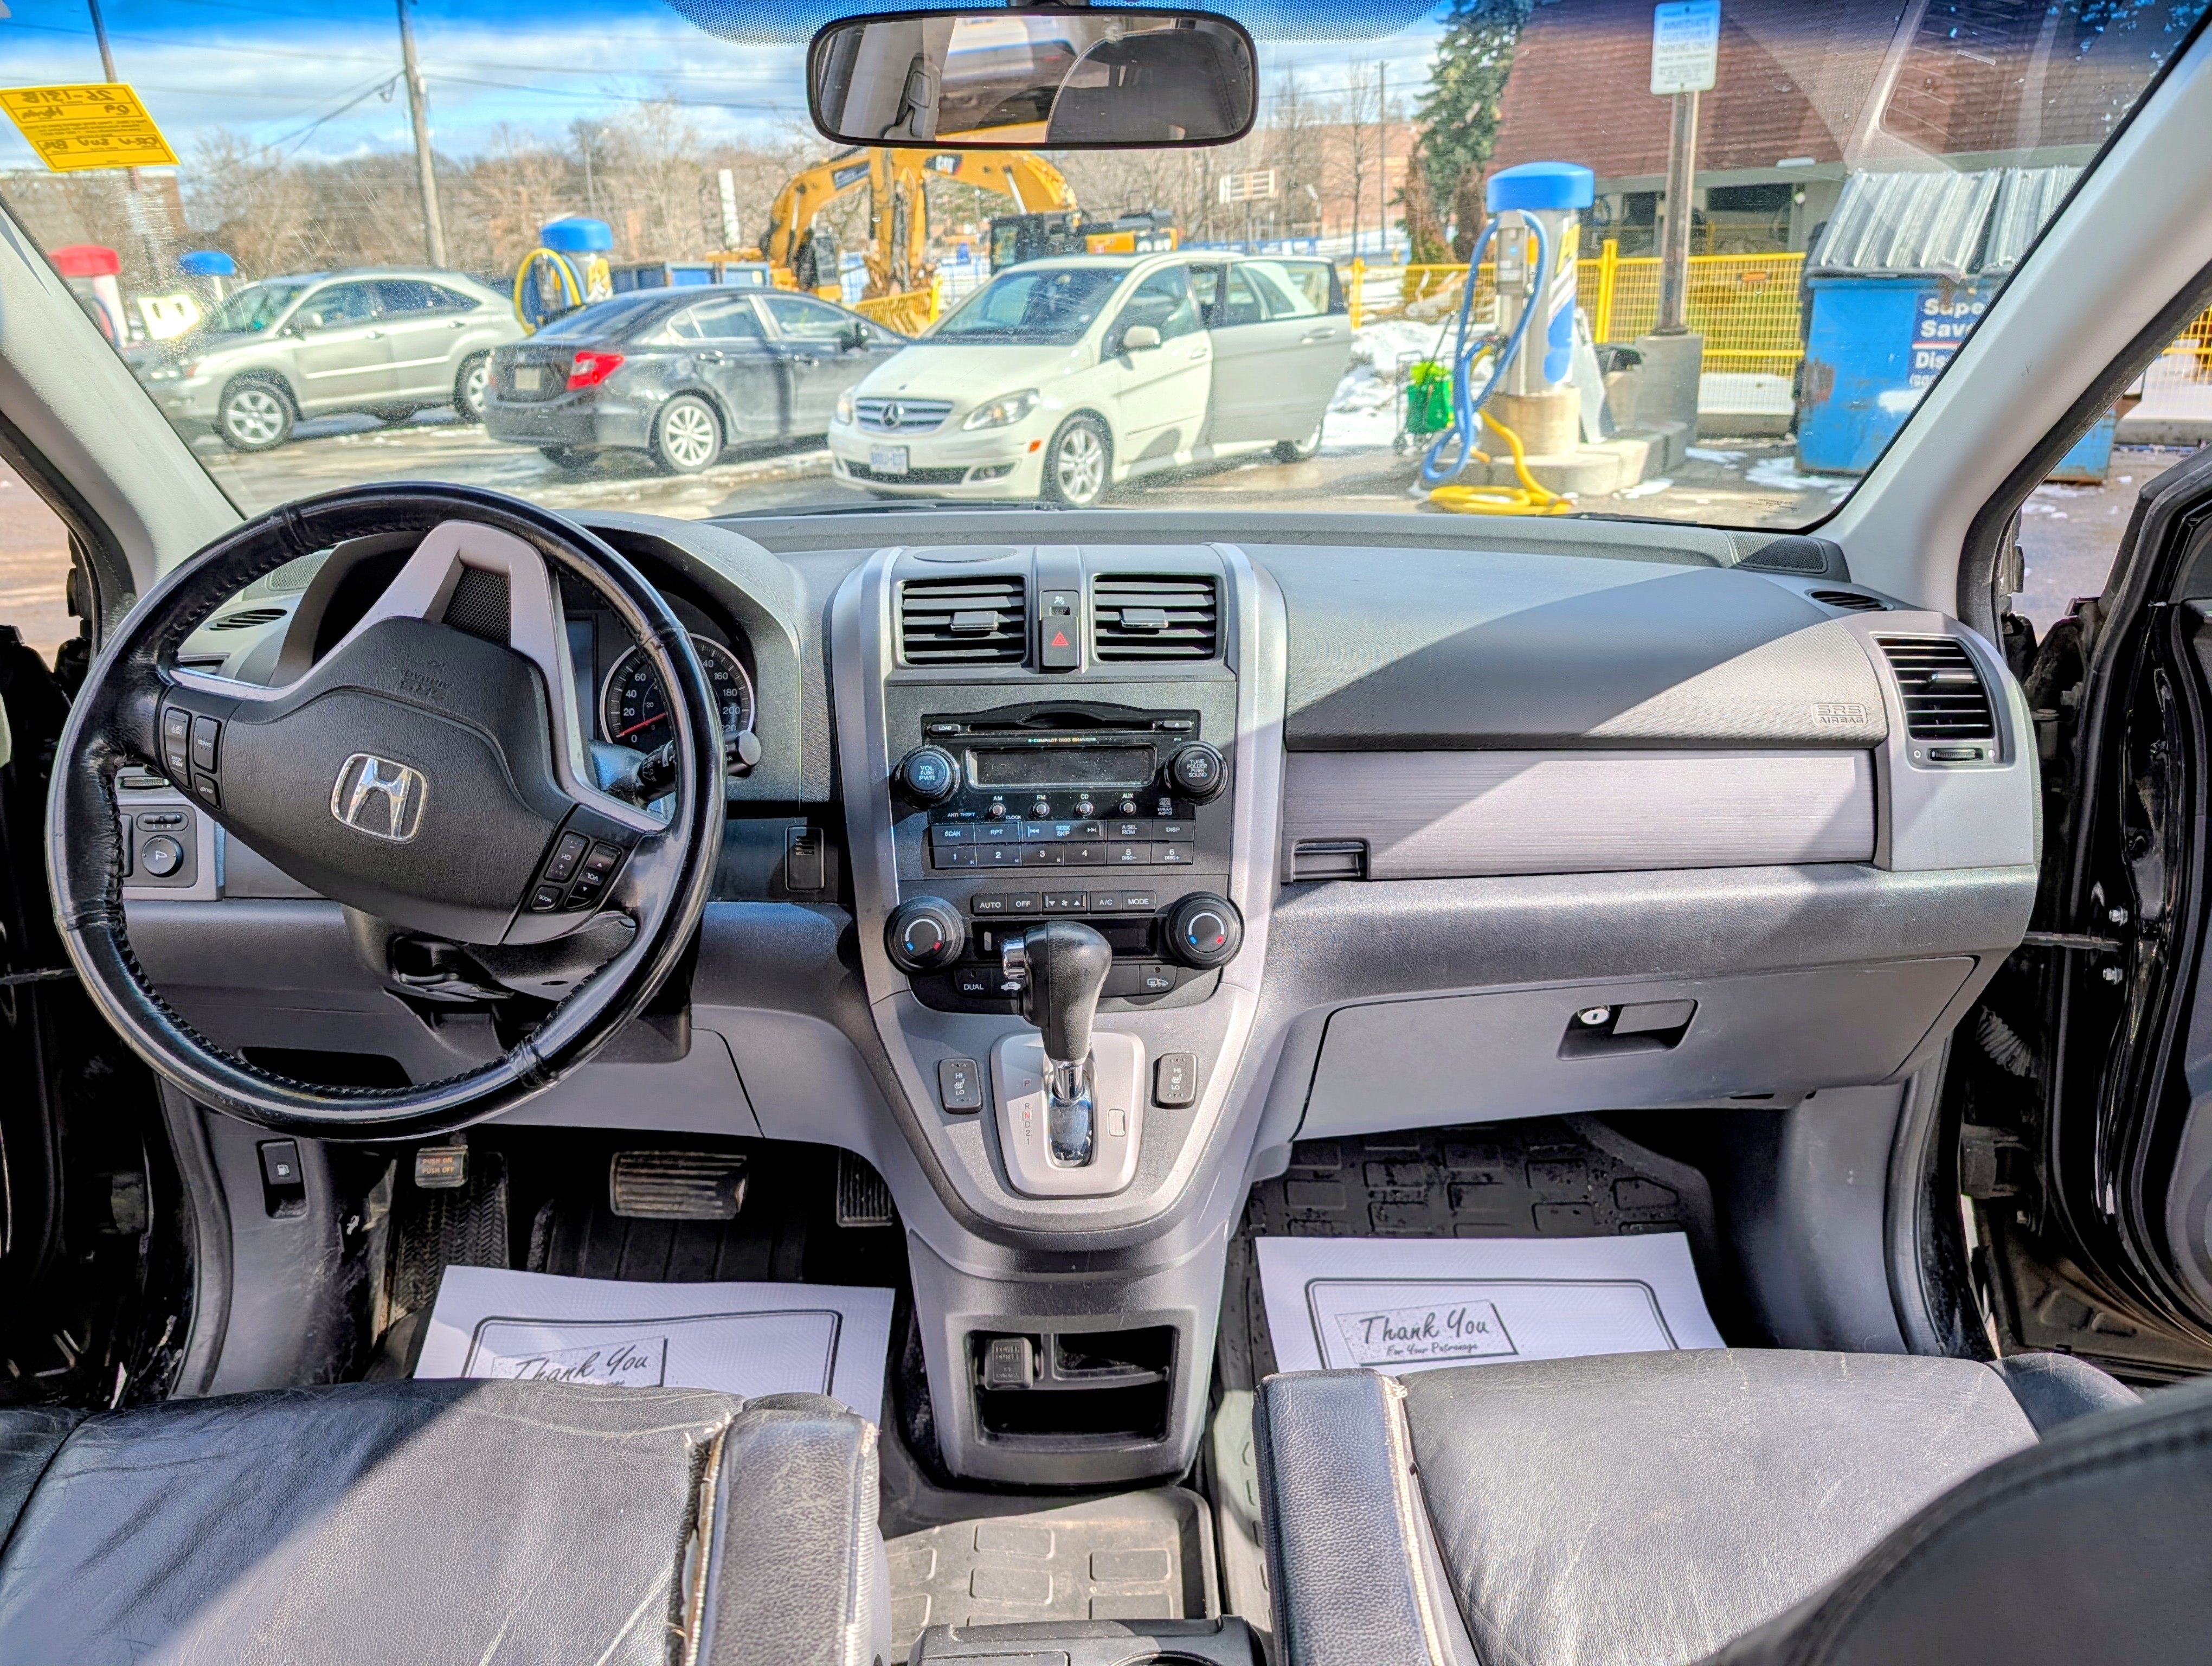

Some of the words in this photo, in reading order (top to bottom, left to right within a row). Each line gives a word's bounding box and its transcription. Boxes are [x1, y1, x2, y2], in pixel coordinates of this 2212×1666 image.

[1924, 298, 1985, 318] Supe
[1915, 351, 1951, 369] Dis
[700, 659, 714, 668] 40
[634, 673, 646, 681] 60
[714, 672, 728, 680] 160
[625, 690, 637, 698] 40
[723, 688, 738, 696] 180
[723, 707, 740, 715] 200
[1817, 705, 1861, 714] SRS
[631, 734, 638, 742] 0
[197, 739, 212, 747] CANCEL
[586, 872, 599, 882] VOL
[538, 895, 552, 903] MODE
[1359, 1312, 1440, 1344] Thank
[1446, 1307, 1489, 1338] You
[1386, 1345, 1404, 1356] For
[1406, 1343, 1429, 1354] Your
[515, 1351, 601, 1382] Thank
[606, 1344, 648, 1376] You
